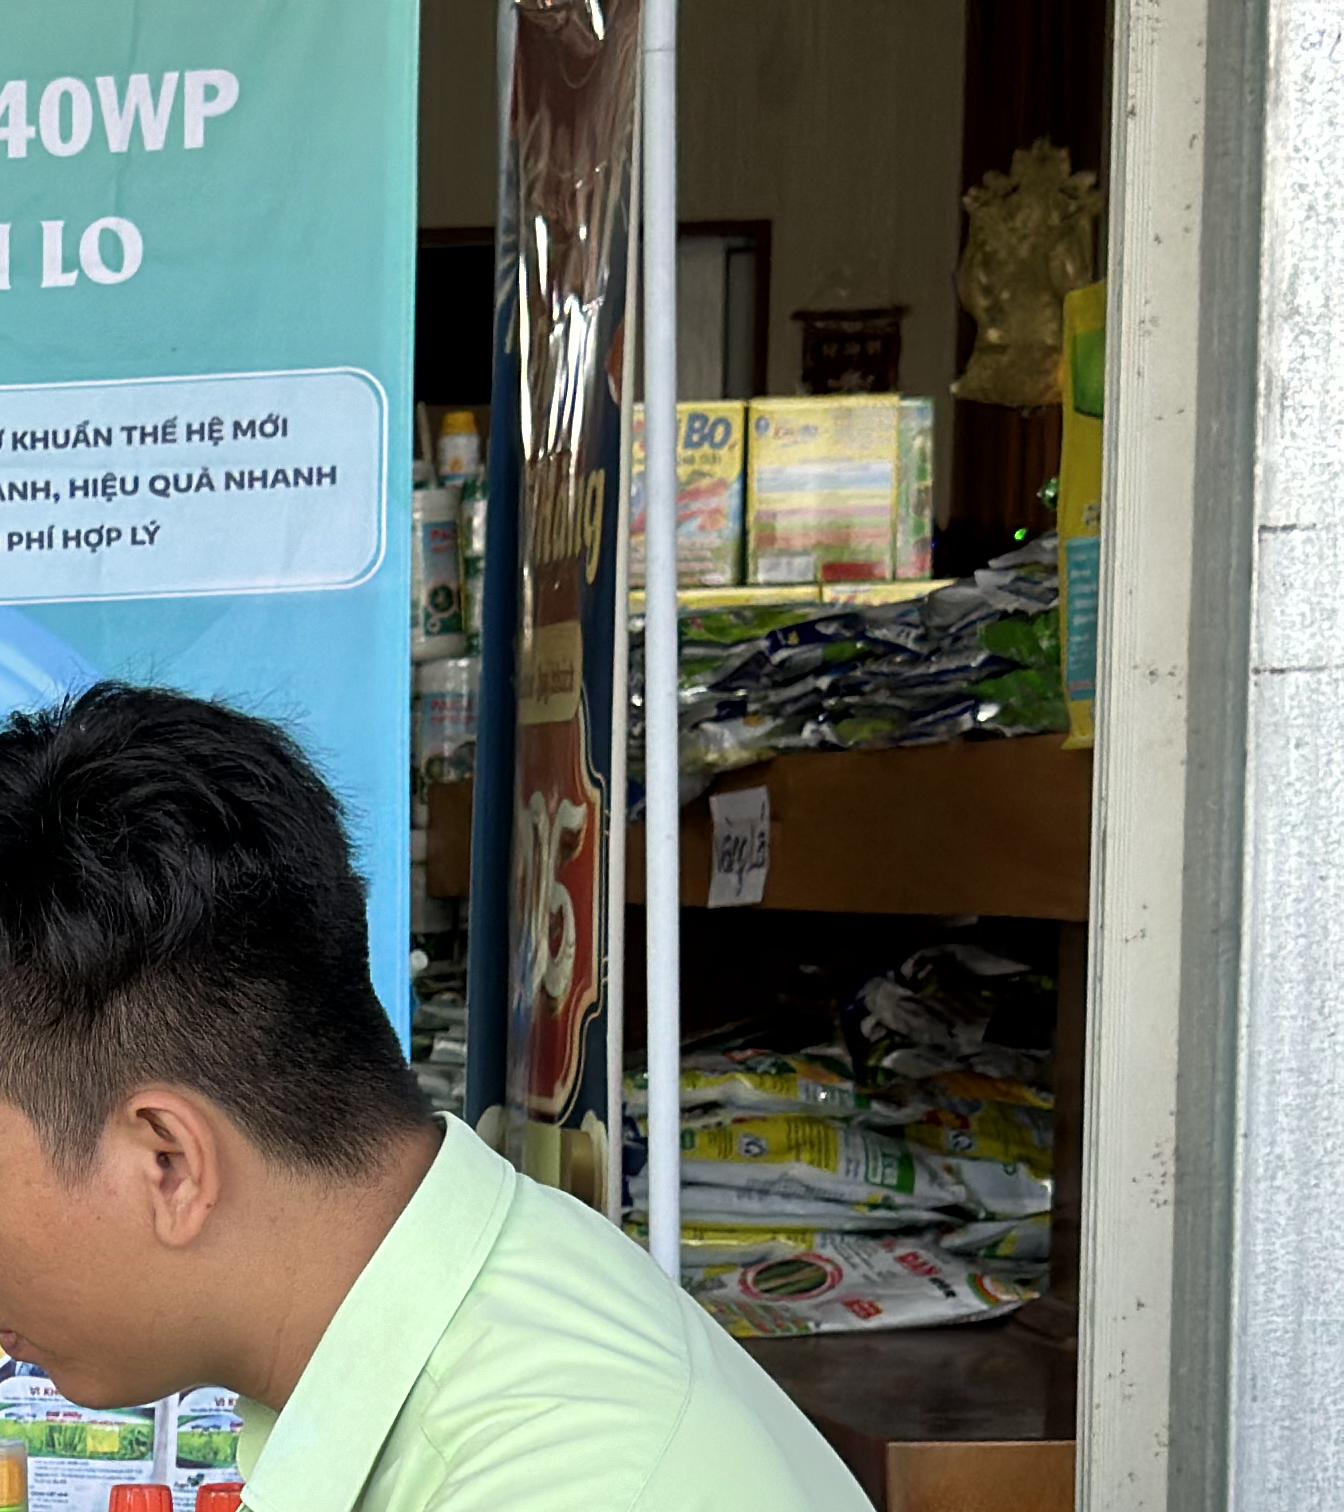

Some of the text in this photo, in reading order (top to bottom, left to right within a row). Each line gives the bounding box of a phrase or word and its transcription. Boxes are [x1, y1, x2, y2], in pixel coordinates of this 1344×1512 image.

[39, 217, 143, 288] LO
[12, 420, 112, 451] KHUẨN
[121, 416, 178, 445] THẾ
[186, 416, 224, 447] HỆ
[233, 413, 288, 440] MỚI
[680, 411, 733, 451] BO
[69, 472, 139, 502] HIỆU
[149, 466, 215, 498] QUẢ
[224, 465, 337, 491] NHANH
[7, 524, 54, 551] PHÍ
[62, 524, 122, 552] HỢP
[131, 519, 160, 546] LÝ
